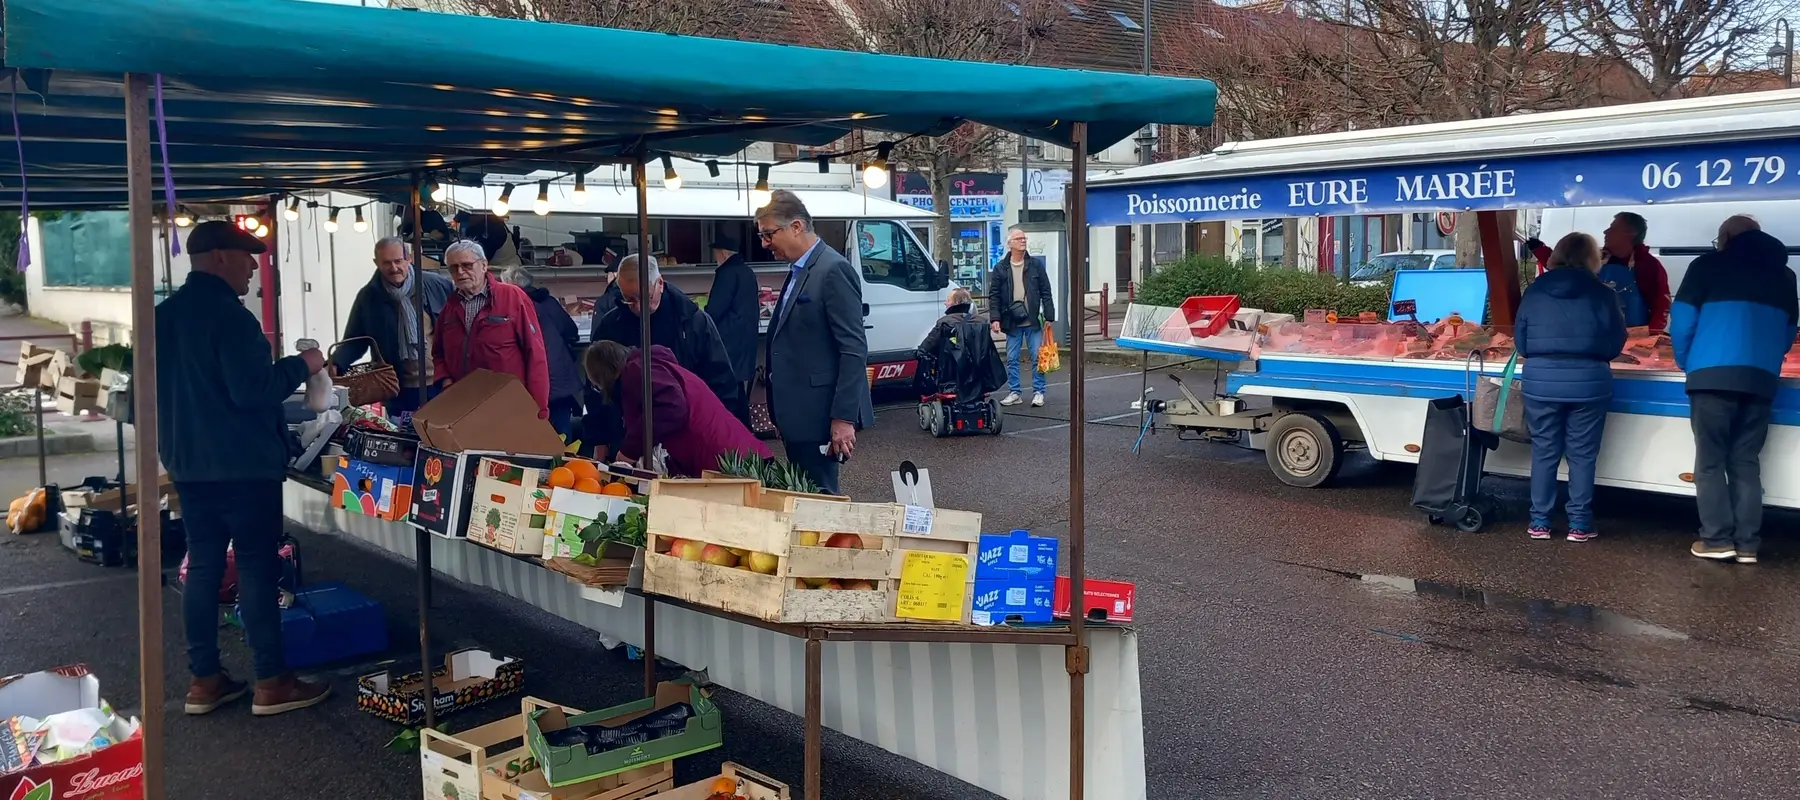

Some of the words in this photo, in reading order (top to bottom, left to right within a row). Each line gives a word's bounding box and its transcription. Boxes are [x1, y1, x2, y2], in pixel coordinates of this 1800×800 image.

[1127, 188, 1262, 216] Poissonnerie
[1288, 179, 1368, 207] EURE
[1395, 164, 1516, 202] MARÉE
[1641, 162, 1682, 190] 06
[1695, 158, 1733, 187] 12
[1744, 155, 1786, 185] 79
[949, 197, 988, 206] CENTER
[877, 363, 906, 379] DCM
[355, 463, 378, 484] AZIZA
[979, 546, 1003, 564] JAZZ
[975, 589, 999, 607] JAZZ
[63, 762, 143, 798] Lucas
